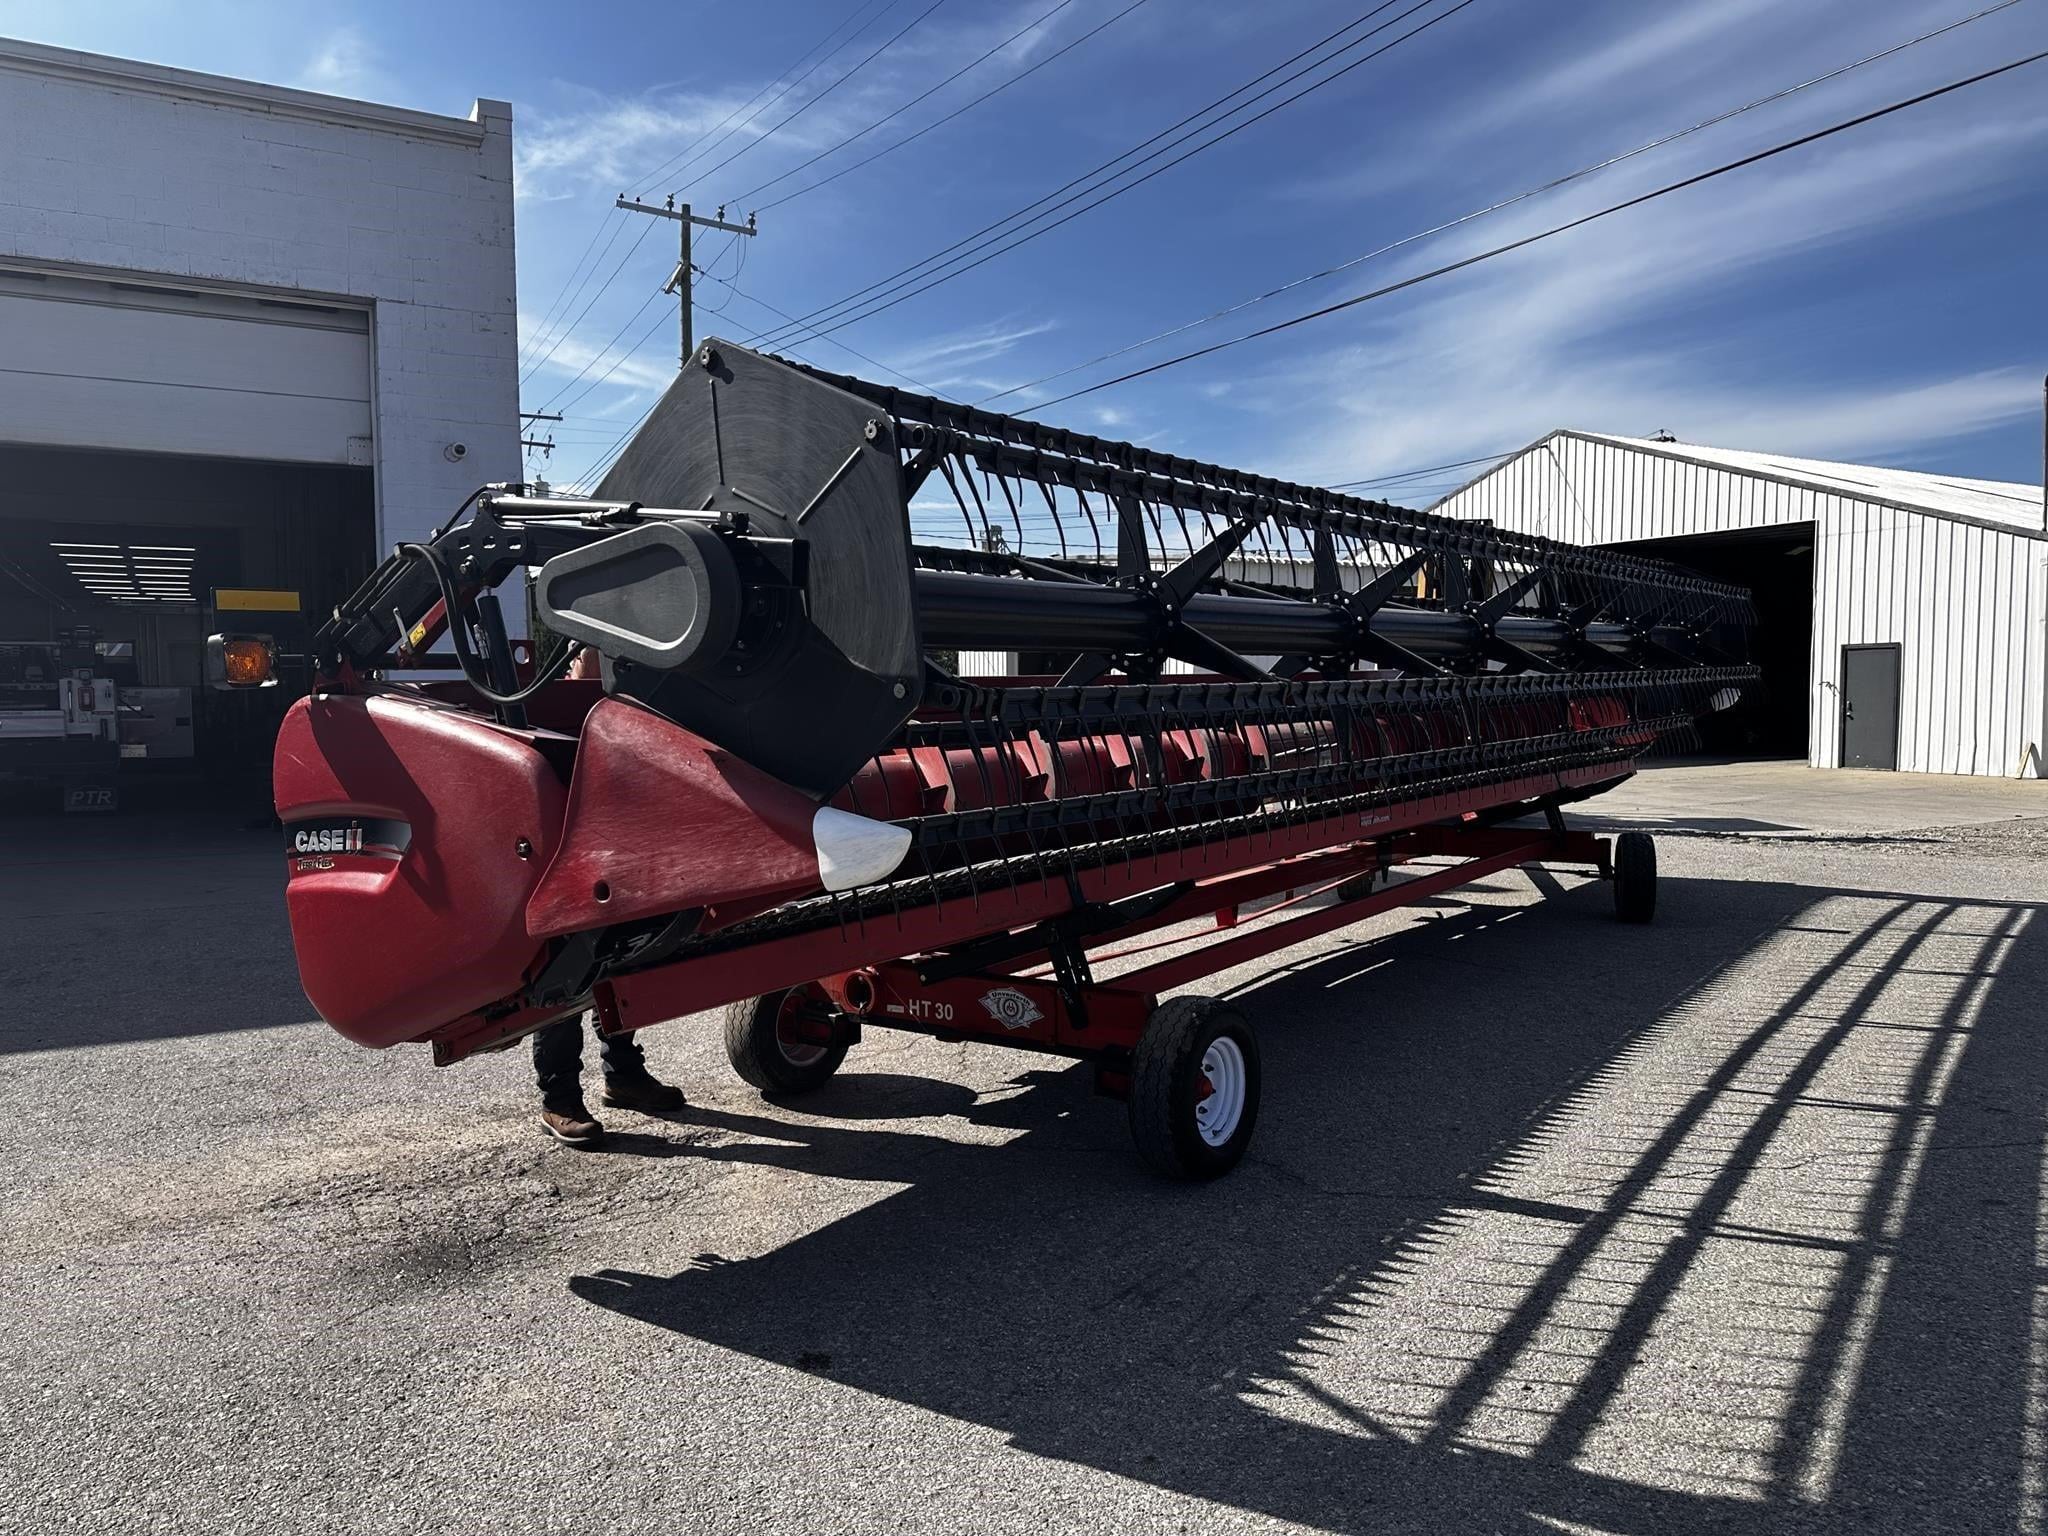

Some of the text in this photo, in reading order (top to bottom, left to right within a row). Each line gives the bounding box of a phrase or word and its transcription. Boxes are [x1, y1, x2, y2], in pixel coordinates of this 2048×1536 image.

[71, 790, 112, 805] PTR
[295, 829, 344, 852] CASE
[909, 999, 932, 1018] HT
[935, 1002, 954, 1021] 30
